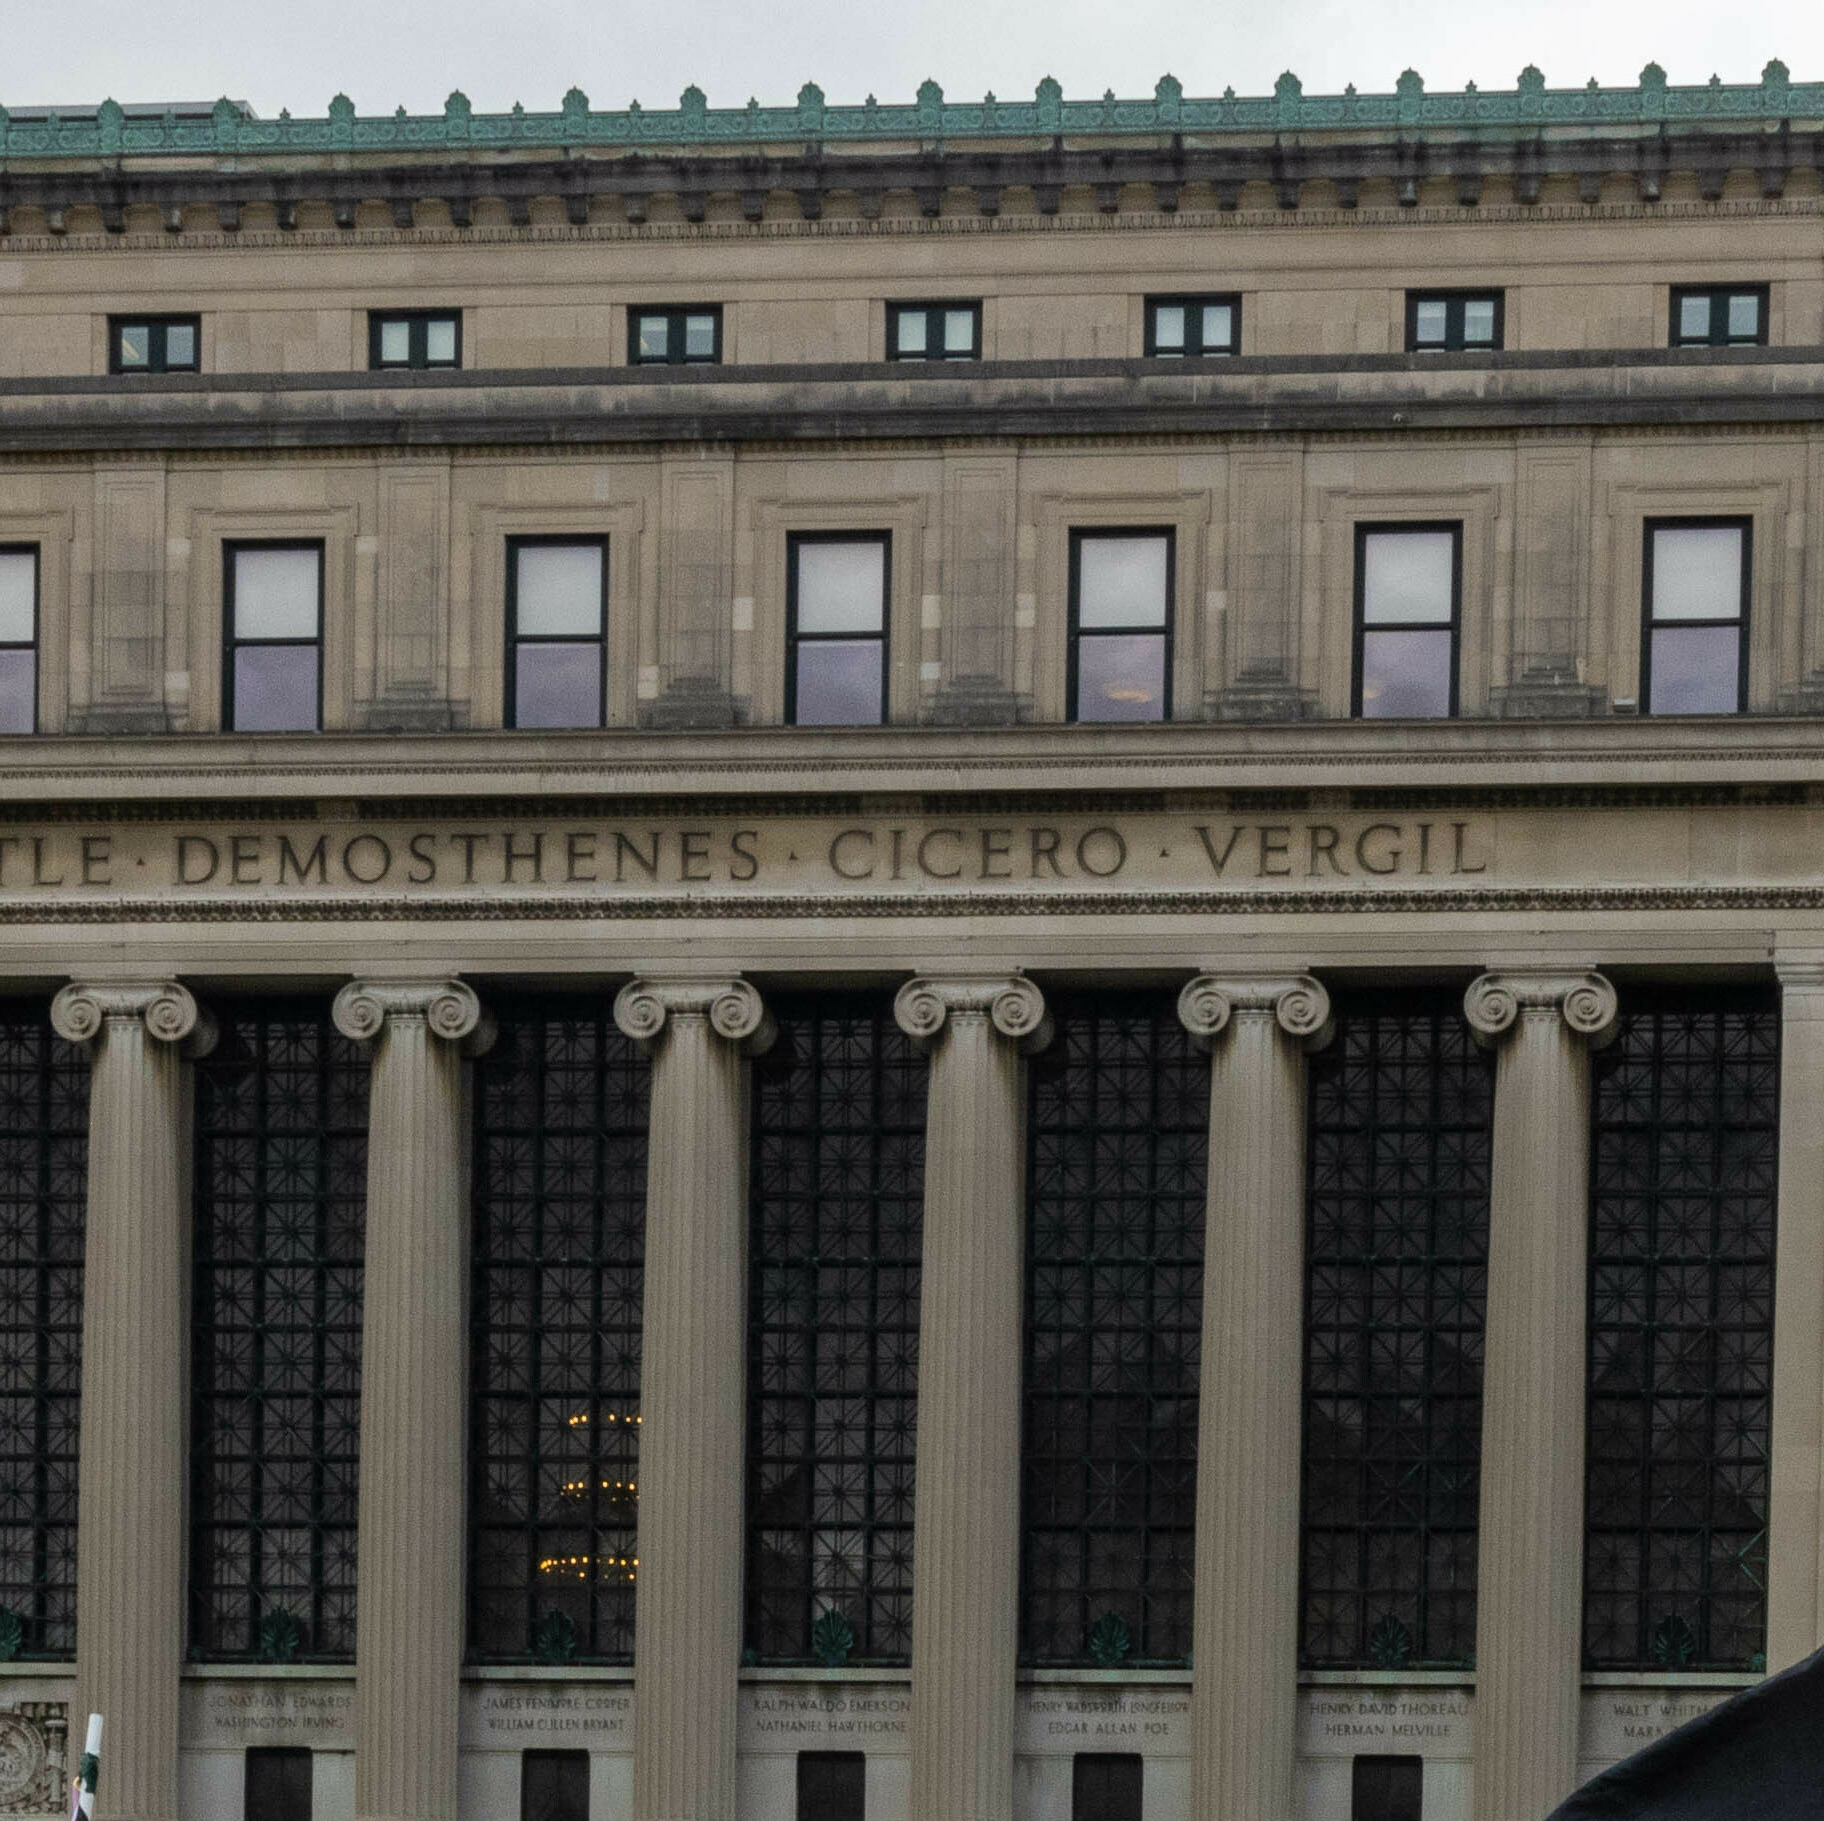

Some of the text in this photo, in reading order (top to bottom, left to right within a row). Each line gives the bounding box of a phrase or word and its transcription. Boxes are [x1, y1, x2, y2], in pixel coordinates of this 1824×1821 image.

[172, 829, 760, 887] DEMOSTHENES
[828, 825, 1130, 881] CICERO
[1195, 822, 1487, 879] VERGIL
[208, 1695, 352, 1709] JONATHAN EDWARDS
[482, 1697, 522, 1710] JAMES
[584, 1697, 630, 1710] COOPER
[754, 1699, 911, 1713] RALPH WALDO EMERSON
[1028, 1701, 1062, 1713] HENRY
[1309, 1702, 1470, 1717] HENRY DAVID THOREAU
[1613, 1703, 1650, 1717] WALT
[214, 1716, 345, 1729] WASHINGTON IRVING
[488, 1718, 624, 1731] WILLIAM CULLEN BRYANT
[756, 1720, 908, 1733] NATHANIEL HAWTHORNE
[1048, 1721, 1170, 1735] EDGAR ALLAN POE
[1325, 1723, 1452, 1737] HERMAN MELVILLE
